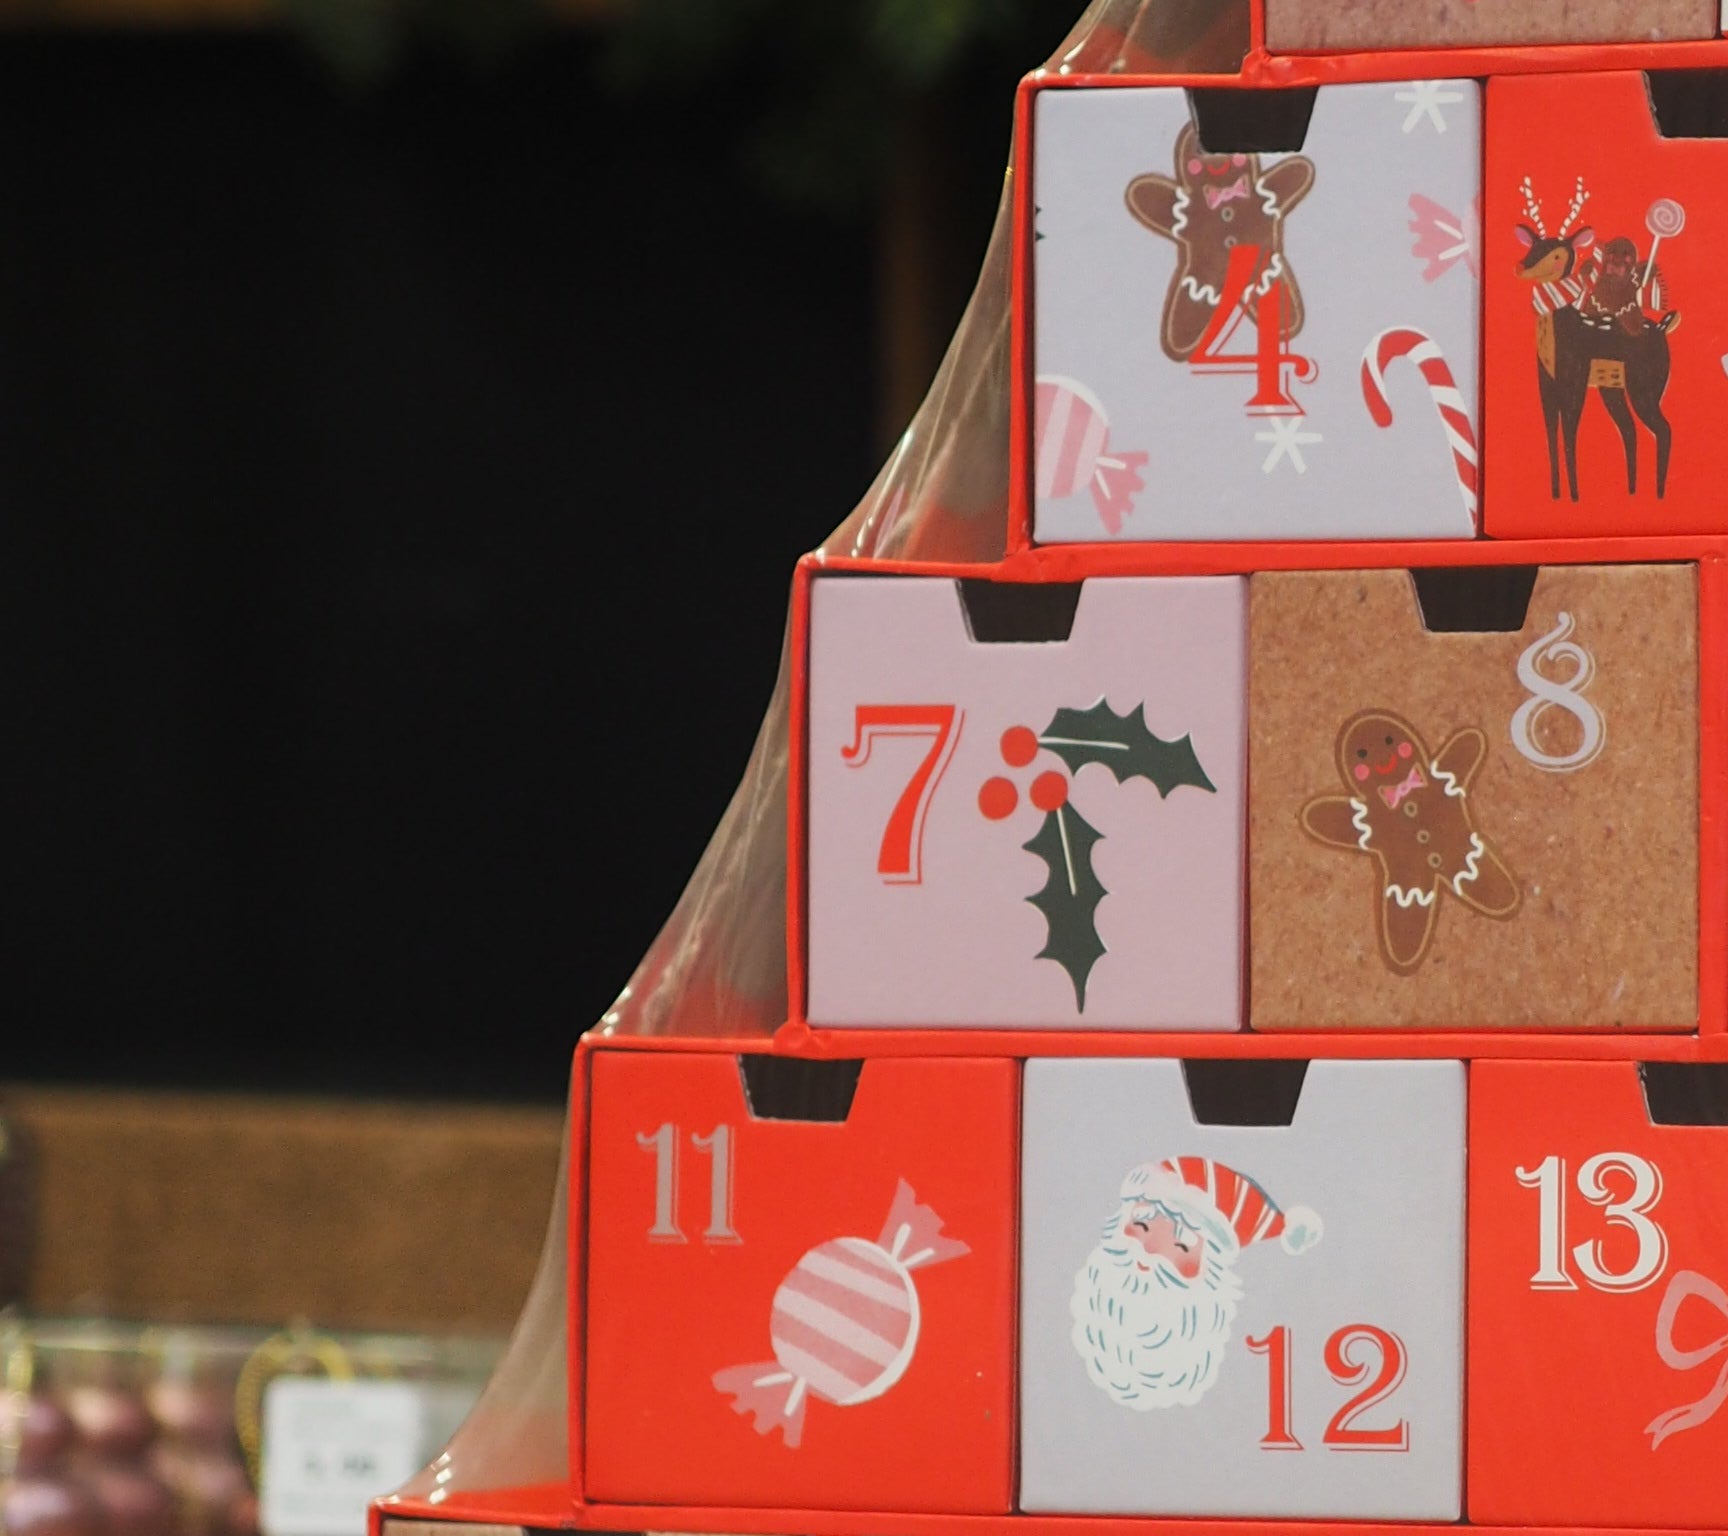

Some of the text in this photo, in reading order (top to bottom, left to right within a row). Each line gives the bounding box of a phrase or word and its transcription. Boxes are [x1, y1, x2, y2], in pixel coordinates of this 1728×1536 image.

[1187, 244, 1318, 418] 4
[1510, 611, 1606, 773] 8
[841, 704, 965, 884] 7
[634, 1122, 744, 1246] 11
[1515, 1151, 1669, 1295] 13
[1245, 1323, 1410, 1452] 12
